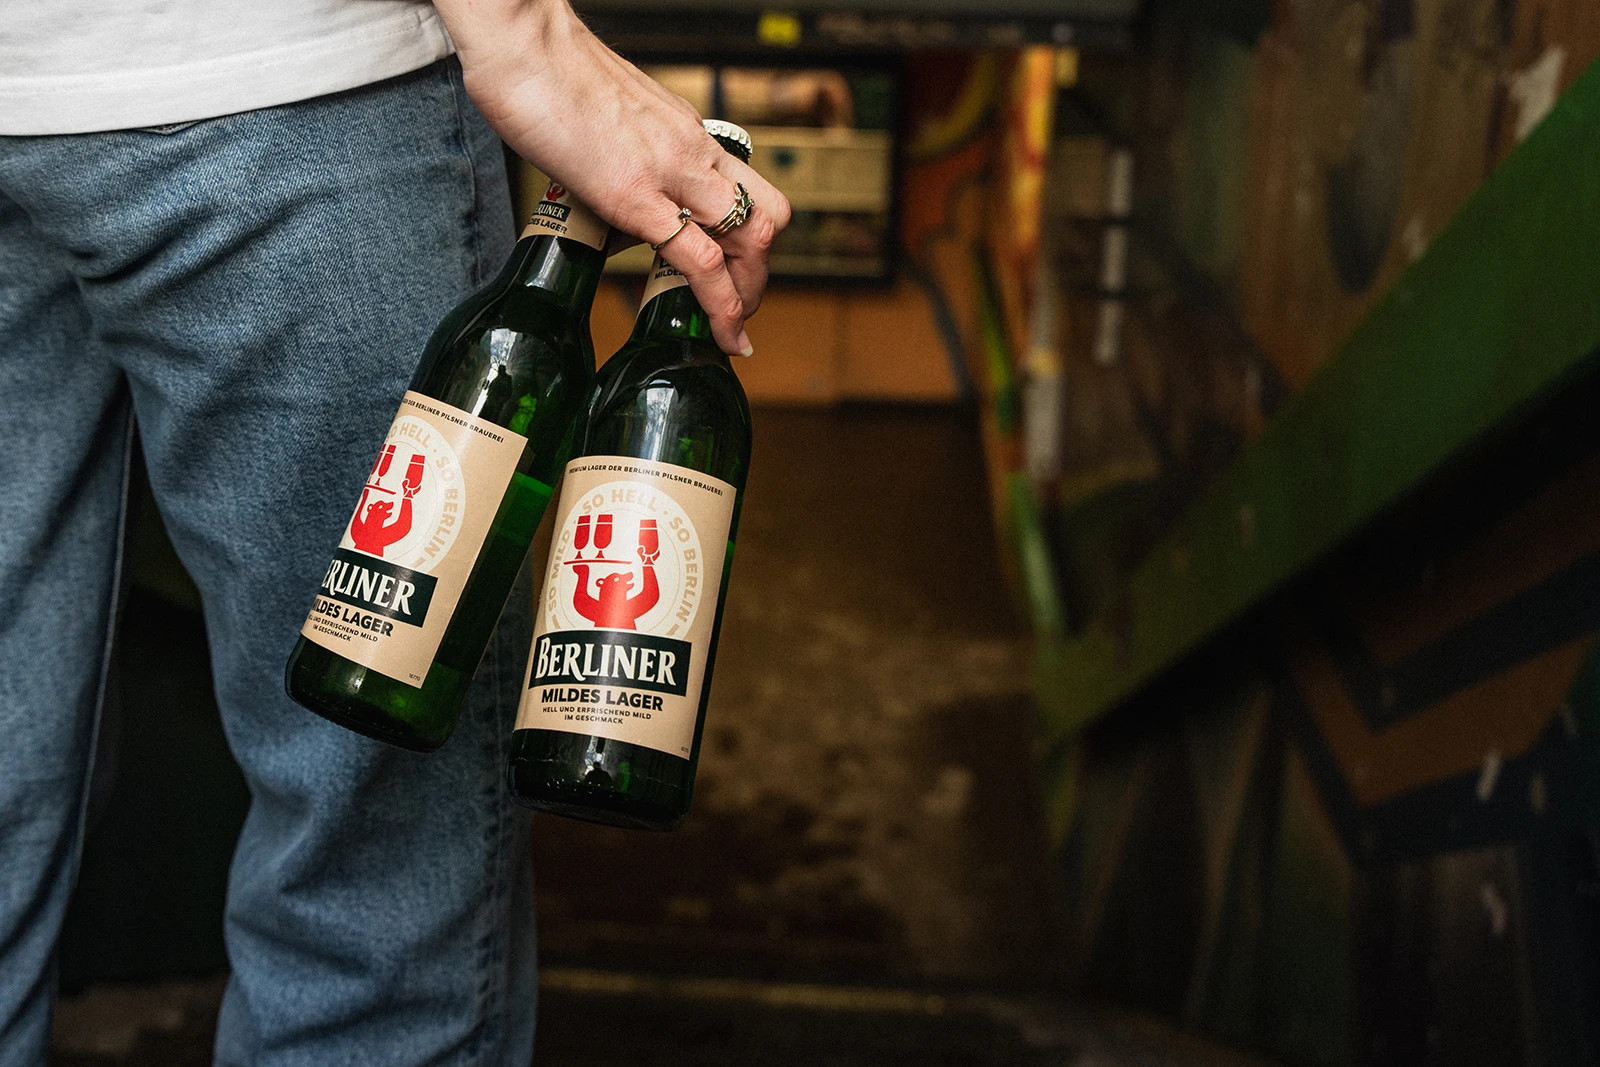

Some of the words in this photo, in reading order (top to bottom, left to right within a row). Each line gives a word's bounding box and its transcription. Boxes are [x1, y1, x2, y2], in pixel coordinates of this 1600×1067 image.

[540, 219, 568, 234] LAGER
[655, 269, 684, 280] MILDE
[399, 422, 431, 449] HELL
[415, 402, 440, 416] BERLINER
[440, 412, 468, 427] PILSNER
[469, 422, 505, 443] BRAUEREI
[435, 455, 455, 482] SO
[624, 466, 660, 477] BERLINER
[662, 472, 692, 485] PILSNER
[693, 480, 723, 496] BRAUEREI
[582, 493, 605, 515] SO
[611, 488, 657, 512] HELL
[423, 488, 460, 559] BERLIN
[669, 515, 691, 544] SO
[551, 529, 571, 580] MILD
[675, 548, 698, 623] BERLIN
[549, 586, 557, 612] SO
[318, 625, 352, 642] GESCHMACK
[321, 618, 359, 636] ERFRISCHEND
[360, 632, 379, 642] MILD
[342, 608, 394, 637] LAGER
[535, 637, 677, 686] BERLINER
[541, 688, 601, 704] MILDES
[605, 690, 664, 711] LAGER
[575, 715, 623, 724] GESCHMACK
[577, 706, 631, 718] ERFRISCHEND
[632, 712, 652, 720] MILD
